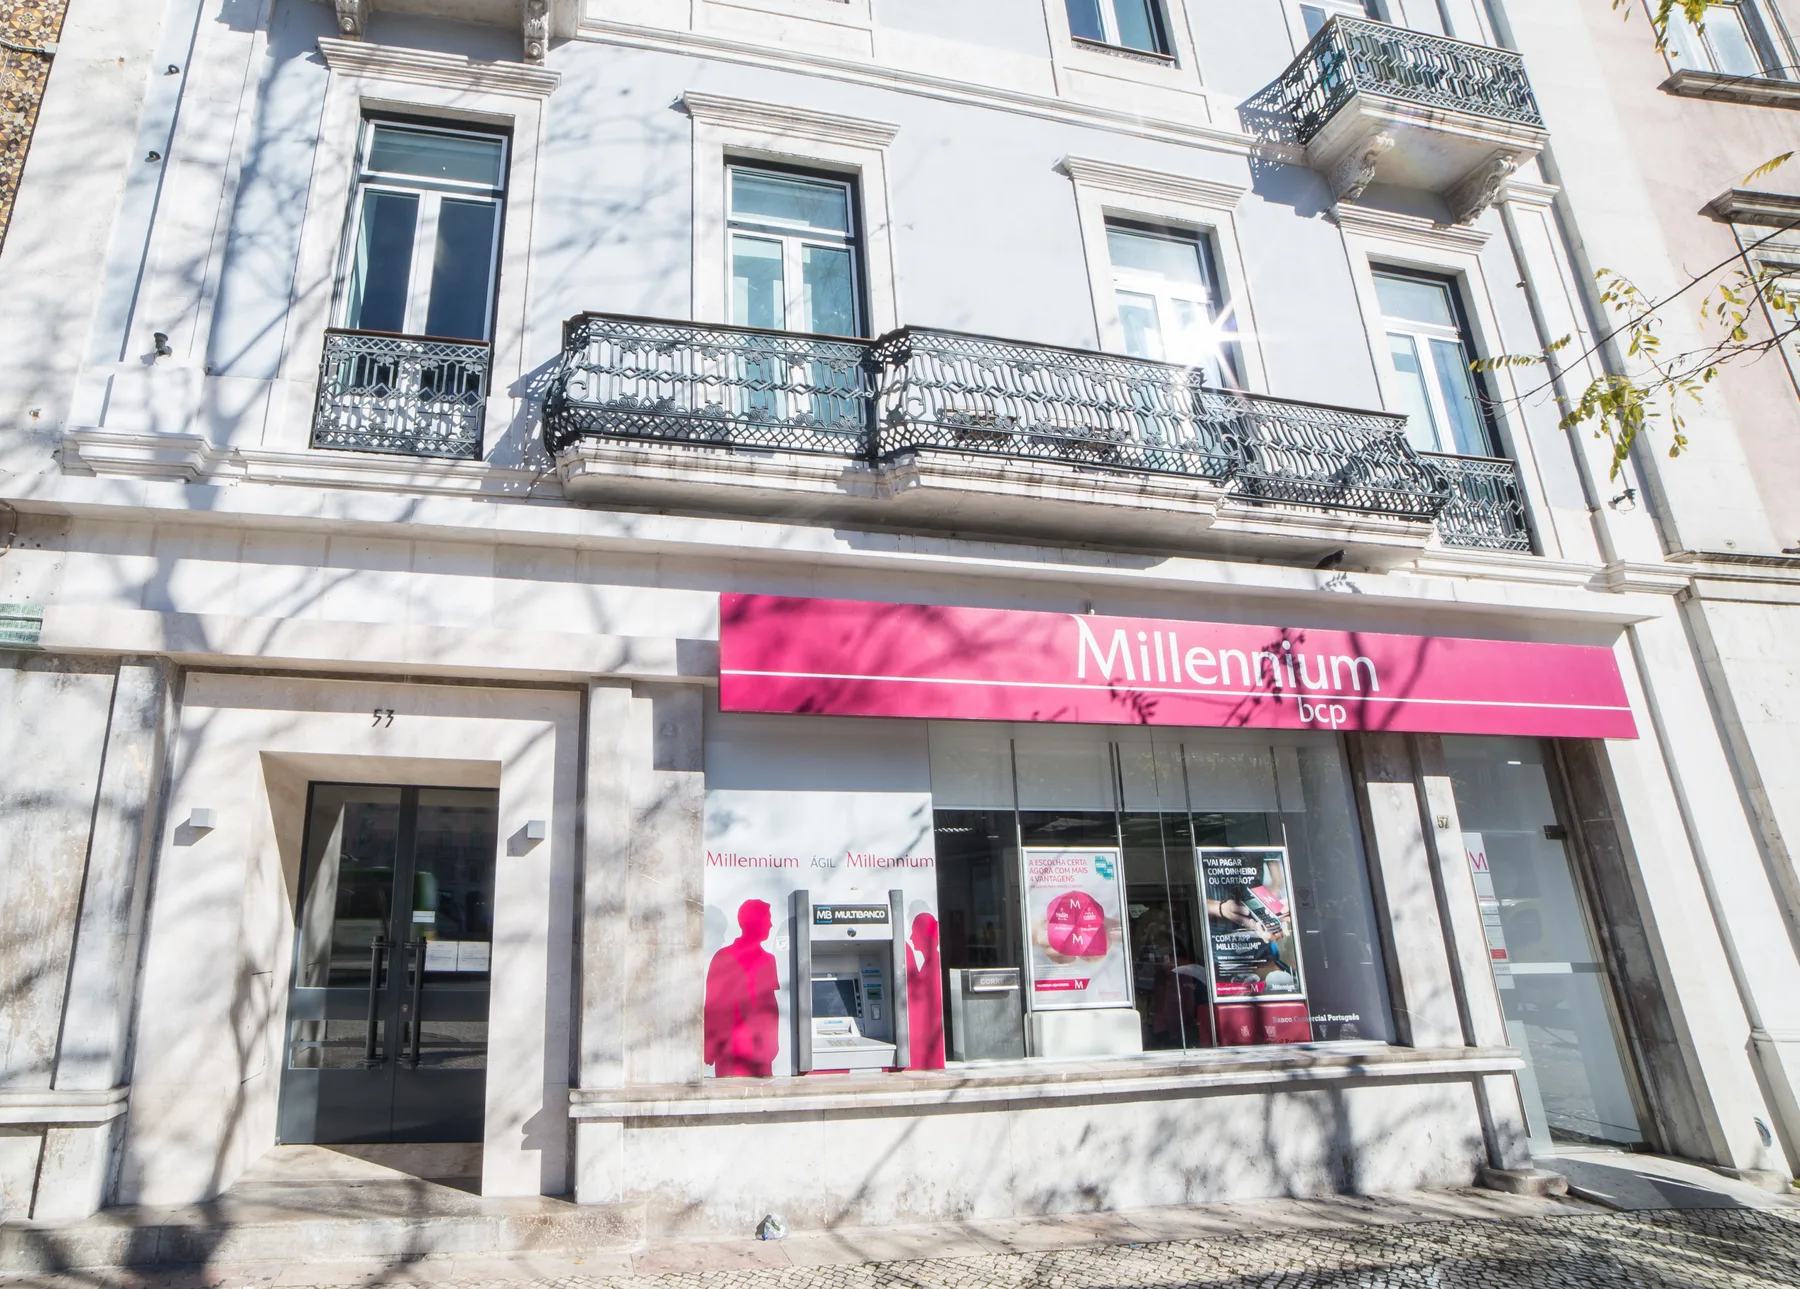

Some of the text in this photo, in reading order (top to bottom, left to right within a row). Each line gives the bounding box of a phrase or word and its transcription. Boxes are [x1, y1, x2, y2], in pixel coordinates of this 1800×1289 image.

[1069, 613, 1380, 692] Millennium
[1297, 696, 1347, 729] bcp
[371, 709, 394, 728] 53
[706, 849, 935, 868] Millennium ÁGIL Millennium
[1220, 858, 1242, 867] PAGAR
[1029, 867, 1054, 875] AGORA
[1208, 867, 1257, 876] COM DINHEIRO
[1208, 877, 1219, 885] OU
[816, 909, 886, 919] MB MULTIBANCO
[1327, 1013, 1360, 1022] Português
